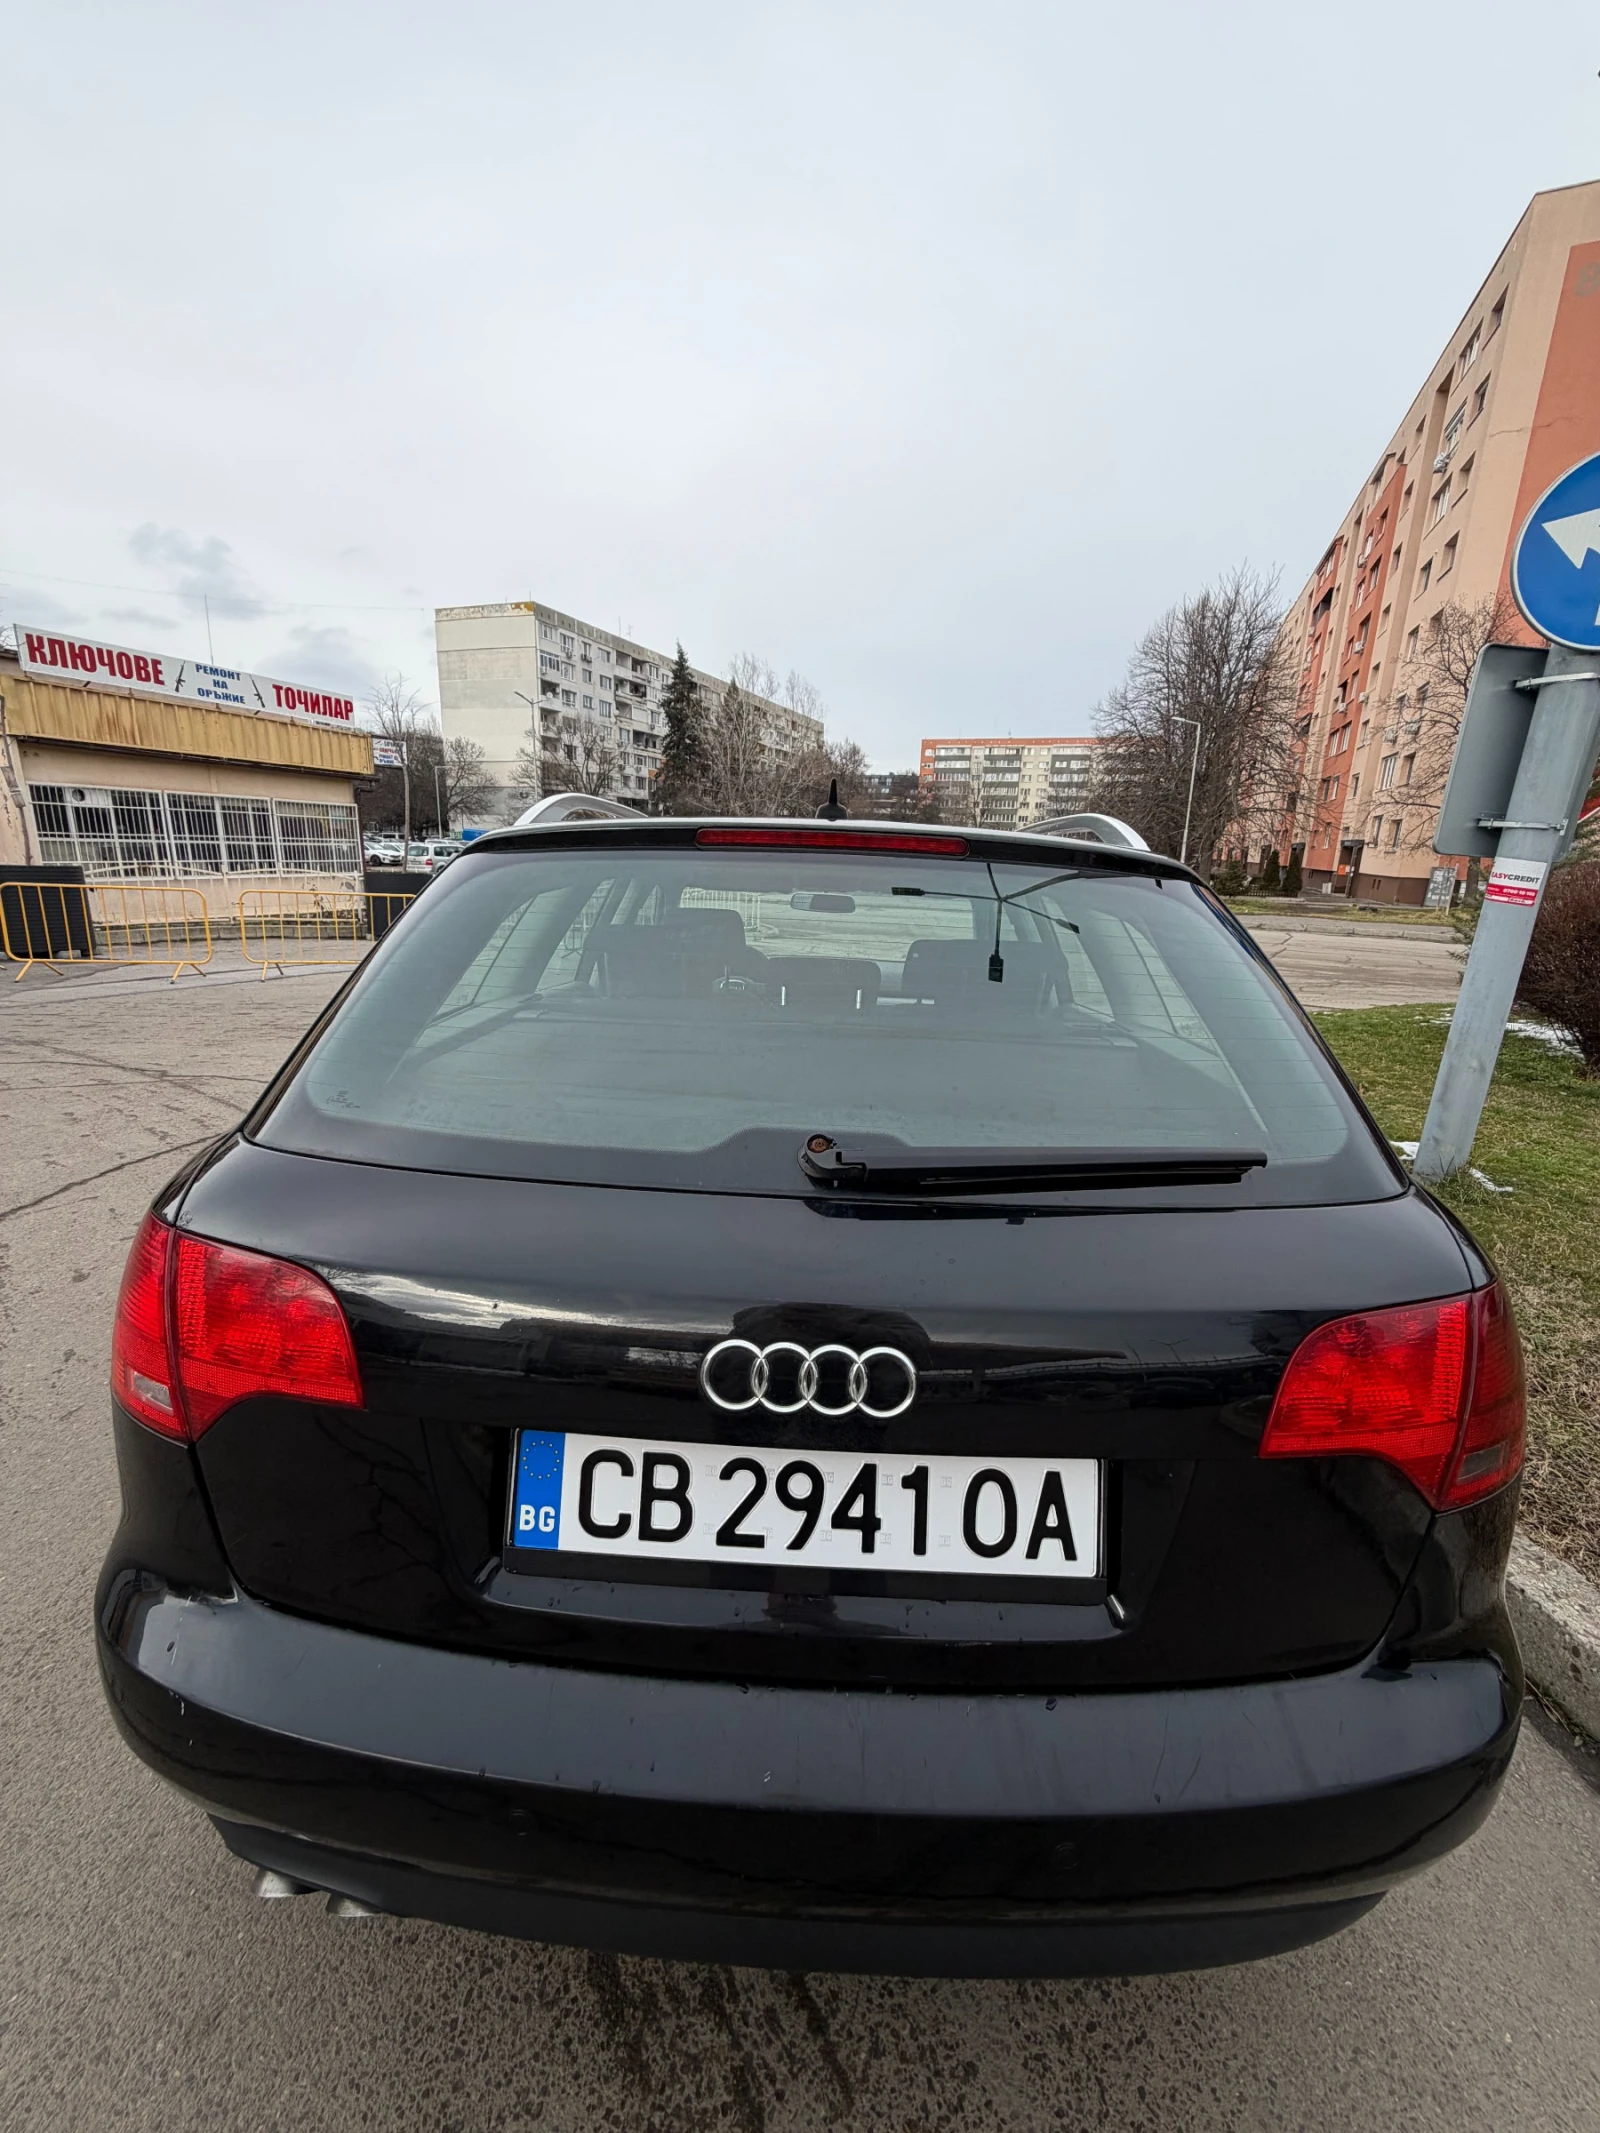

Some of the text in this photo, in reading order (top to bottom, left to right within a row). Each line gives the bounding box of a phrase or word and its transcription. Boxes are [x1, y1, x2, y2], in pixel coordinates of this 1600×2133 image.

[25, 633, 165, 686] КЛЮЧОВЕ
[195, 663, 241, 682] РЕМОНТ
[197, 687, 246, 704] ОРЪЖИЕ
[212, 678, 229, 690] НА
[272, 683, 354, 721] ТОЧИЛАР
[518, 1449, 1078, 1562] BG CB 2941 OA
